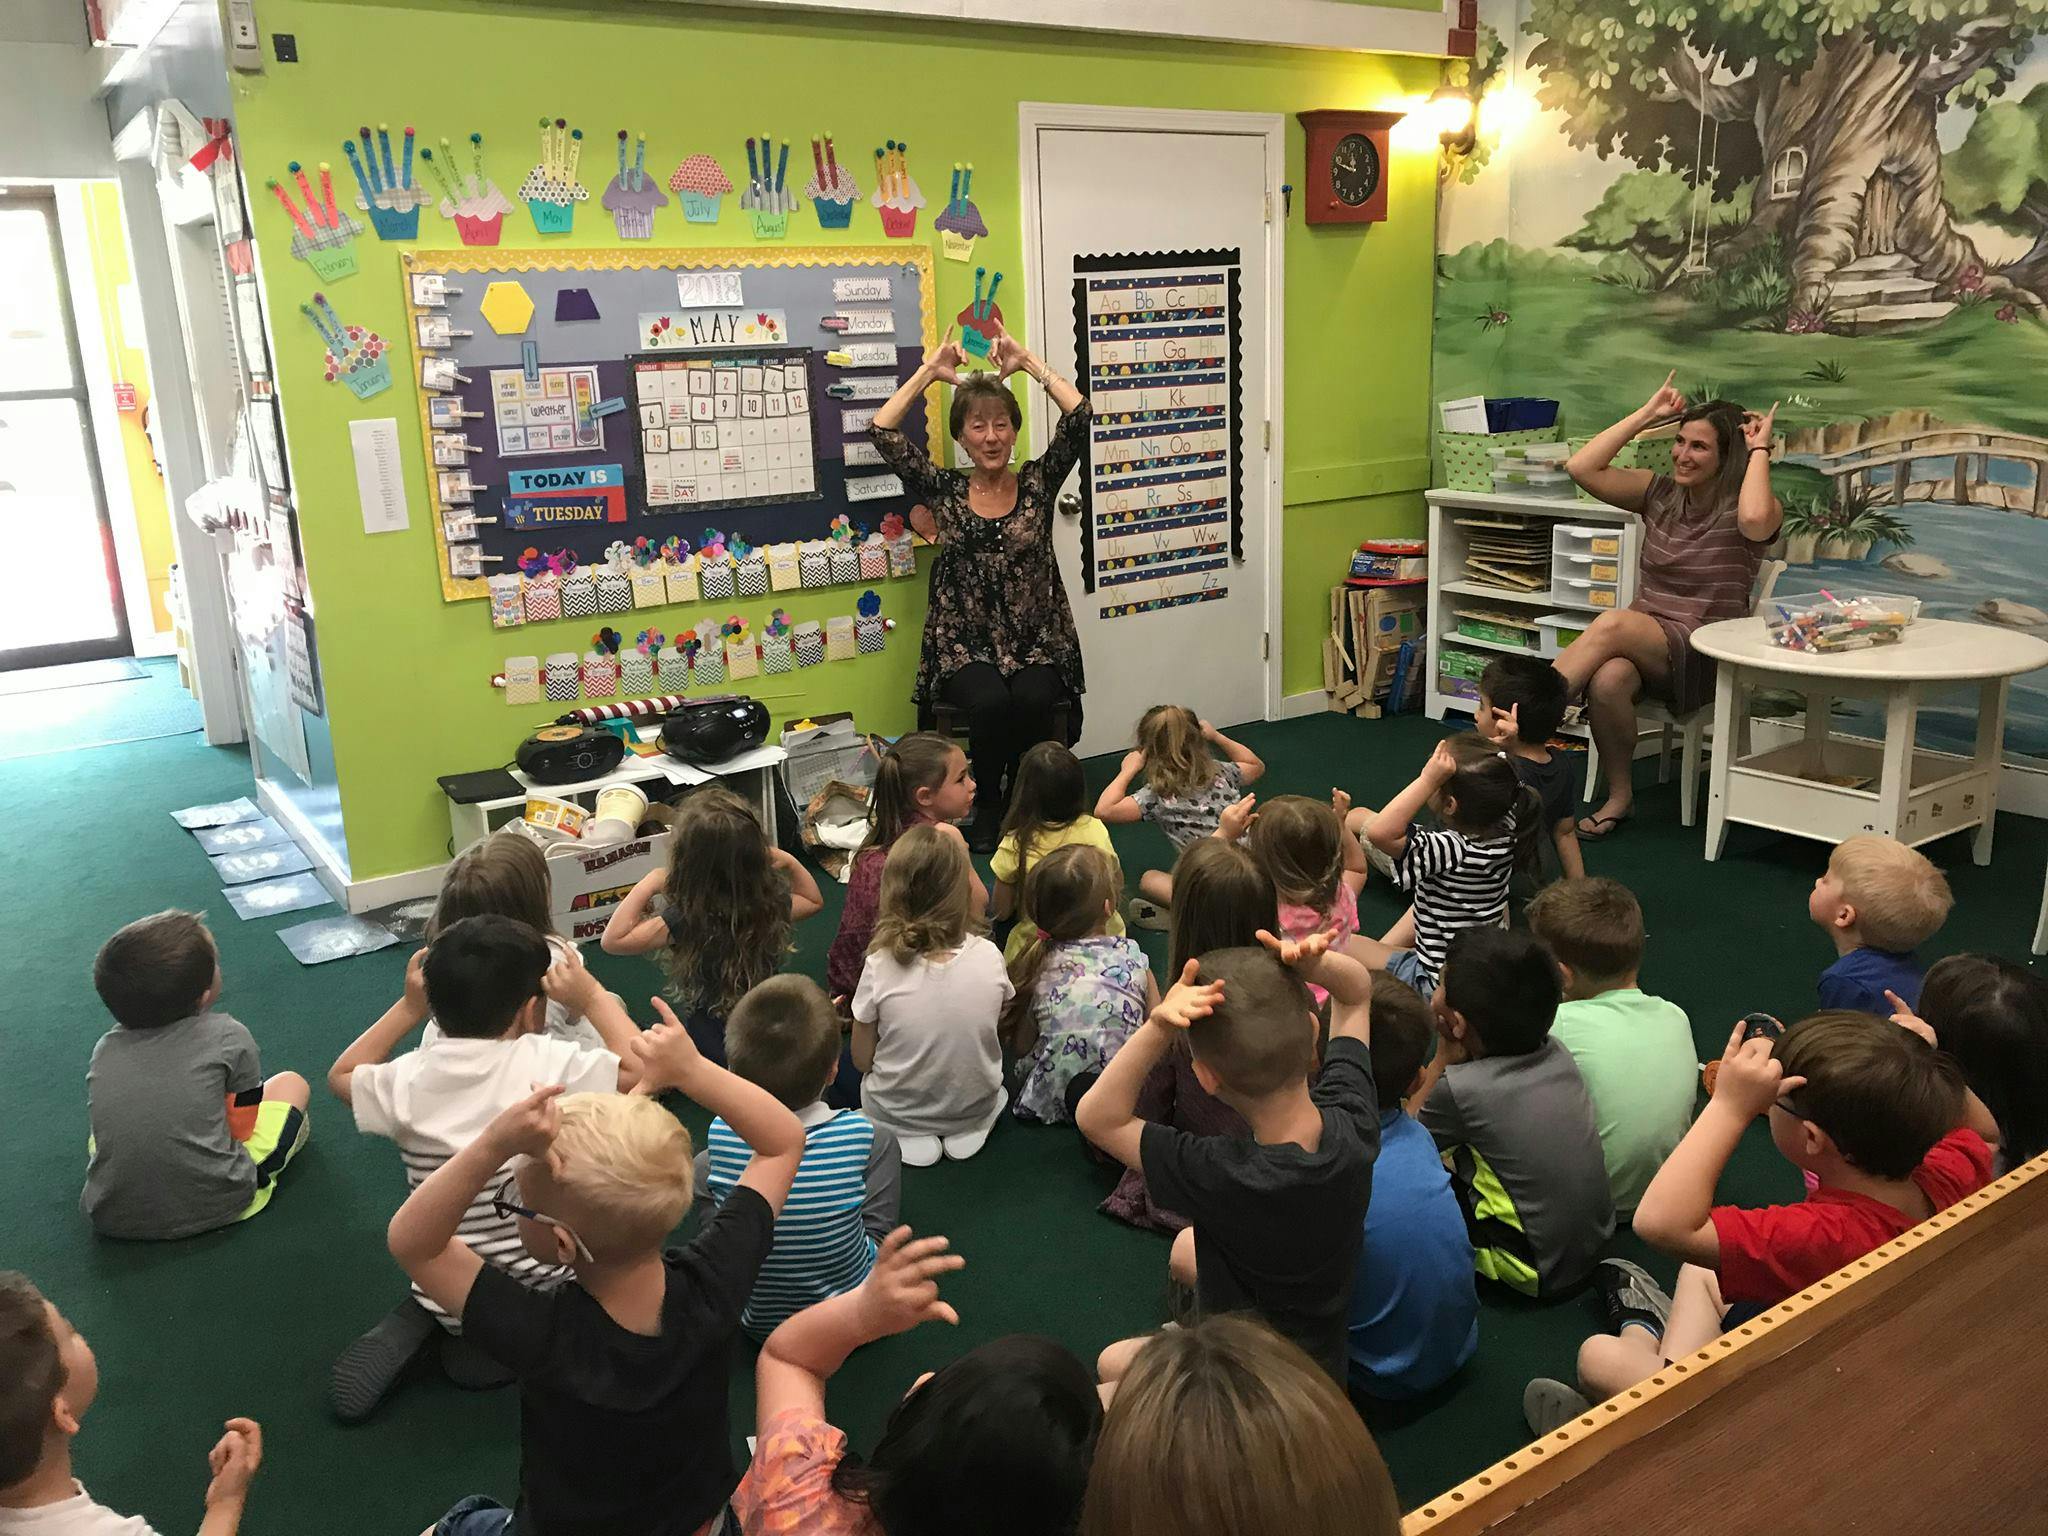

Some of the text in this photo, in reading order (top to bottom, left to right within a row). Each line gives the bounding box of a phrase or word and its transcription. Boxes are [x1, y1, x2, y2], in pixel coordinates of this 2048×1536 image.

[1333, 168, 1339, 176] 9
[1335, 181, 1341, 189] 8
[687, 200, 711, 218] July
[543, 211, 563, 225] May
[756, 216, 785, 236] August
[463, 223, 490, 241] April
[314, 255, 354, 276] February
[679, 273, 742, 305] 2018
[844, 284, 883, 298] Sunday
[1100, 287, 1218, 312] Aa Bb Cc Dd
[690, 314, 741, 345] MAY
[849, 314, 889, 331] Monday
[851, 348, 890, 365] Tuesday
[1100, 344, 1119, 363] Ee
[1134, 342, 1148, 361] Ff
[1200, 339, 1218, 356] Hh
[350, 371, 387, 395] January
[723, 377, 729, 391] 2
[771, 375, 776, 388] 4
[792, 371, 797, 384] 5
[722, 400, 728, 413] 9
[747, 400, 757, 413] 10
[772, 399, 780, 412] 11
[793, 396, 803, 409] 12
[1138, 391, 1149, 411] Jj
[1169, 388, 1187, 407] Kk
[531, 404, 567, 417] weather
[700, 402, 707, 415] 8
[649, 411, 655, 424] 6
[653, 435, 662, 448] 13
[701, 431, 711, 444] 15
[1103, 445, 1130, 462] Mm
[1140, 440, 1161, 457] Nn
[1170, 435, 1191, 454] Oo
[520, 470, 608, 489] TODAY IS
[674, 489, 696, 498] DAY
[854, 480, 899, 497] Saturday
[1147, 488, 1162, 506] Rr
[1177, 484, 1193, 503] Ss
[1207, 480, 1219, 497] Tt
[533, 505, 604, 522] TUESDAY
[1107, 527, 1219, 558] Uu Vv Ww
[1110, 587, 1128, 606] Xx
[1202, 573, 1218, 590] Zz
